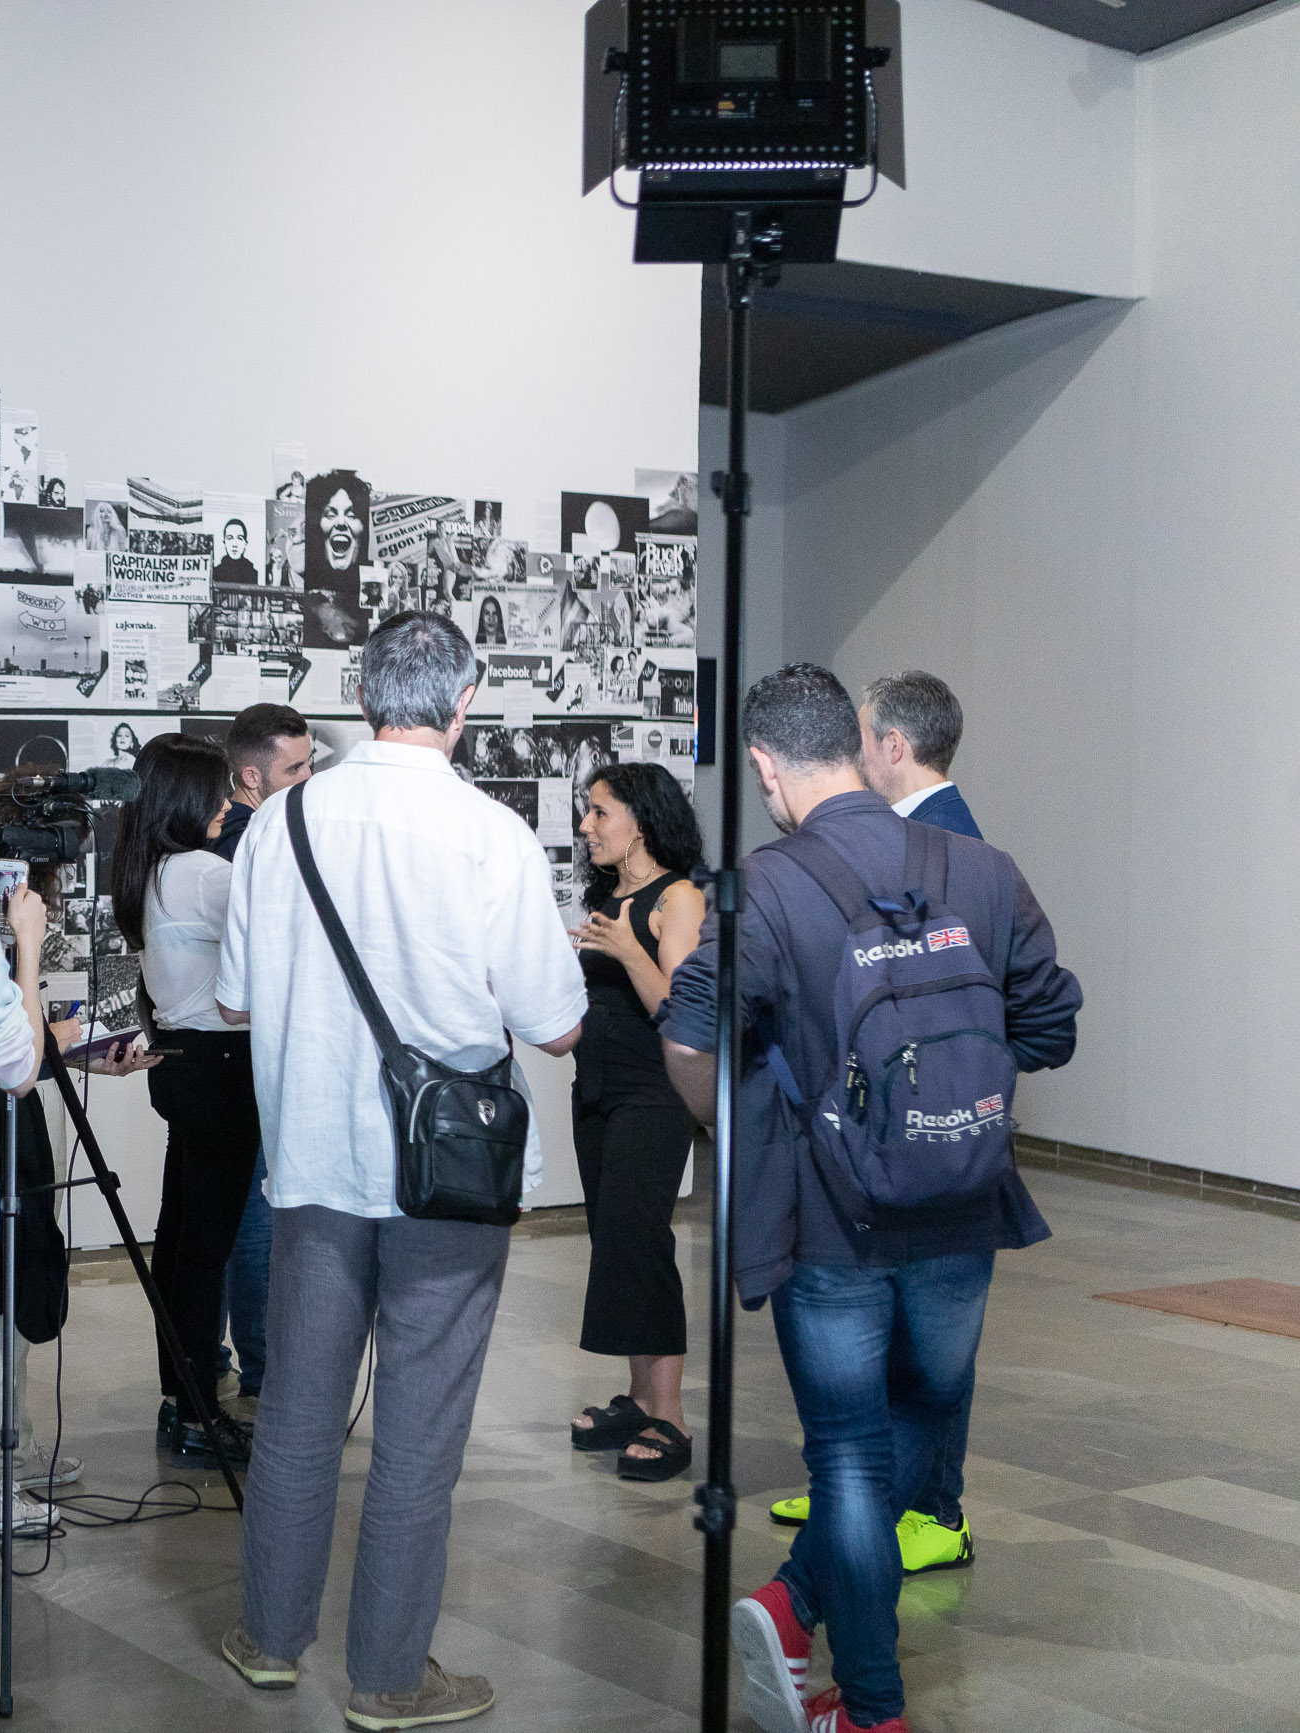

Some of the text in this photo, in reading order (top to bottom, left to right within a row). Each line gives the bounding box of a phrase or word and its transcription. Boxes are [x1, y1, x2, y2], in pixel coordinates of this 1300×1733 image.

[373, 496, 446, 525] Egunkaria
[375, 521, 426, 545] Euskara
[377, 537, 416, 558] egon
[645, 542, 684, 563] BUCK
[111, 554, 209, 571] CAPITALISM ISN'T
[113, 567, 175, 583] WORKING
[18, 592, 58, 609] DEMOCRACY
[32, 617, 57, 630] WTO
[488, 663, 530, 679] facebook
[659, 671, 694, 694] Googl
[673, 697, 693, 715] Tube
[854, 939, 924, 967] Rebok
[905, 1113, 1005, 1142] CLASSIC
